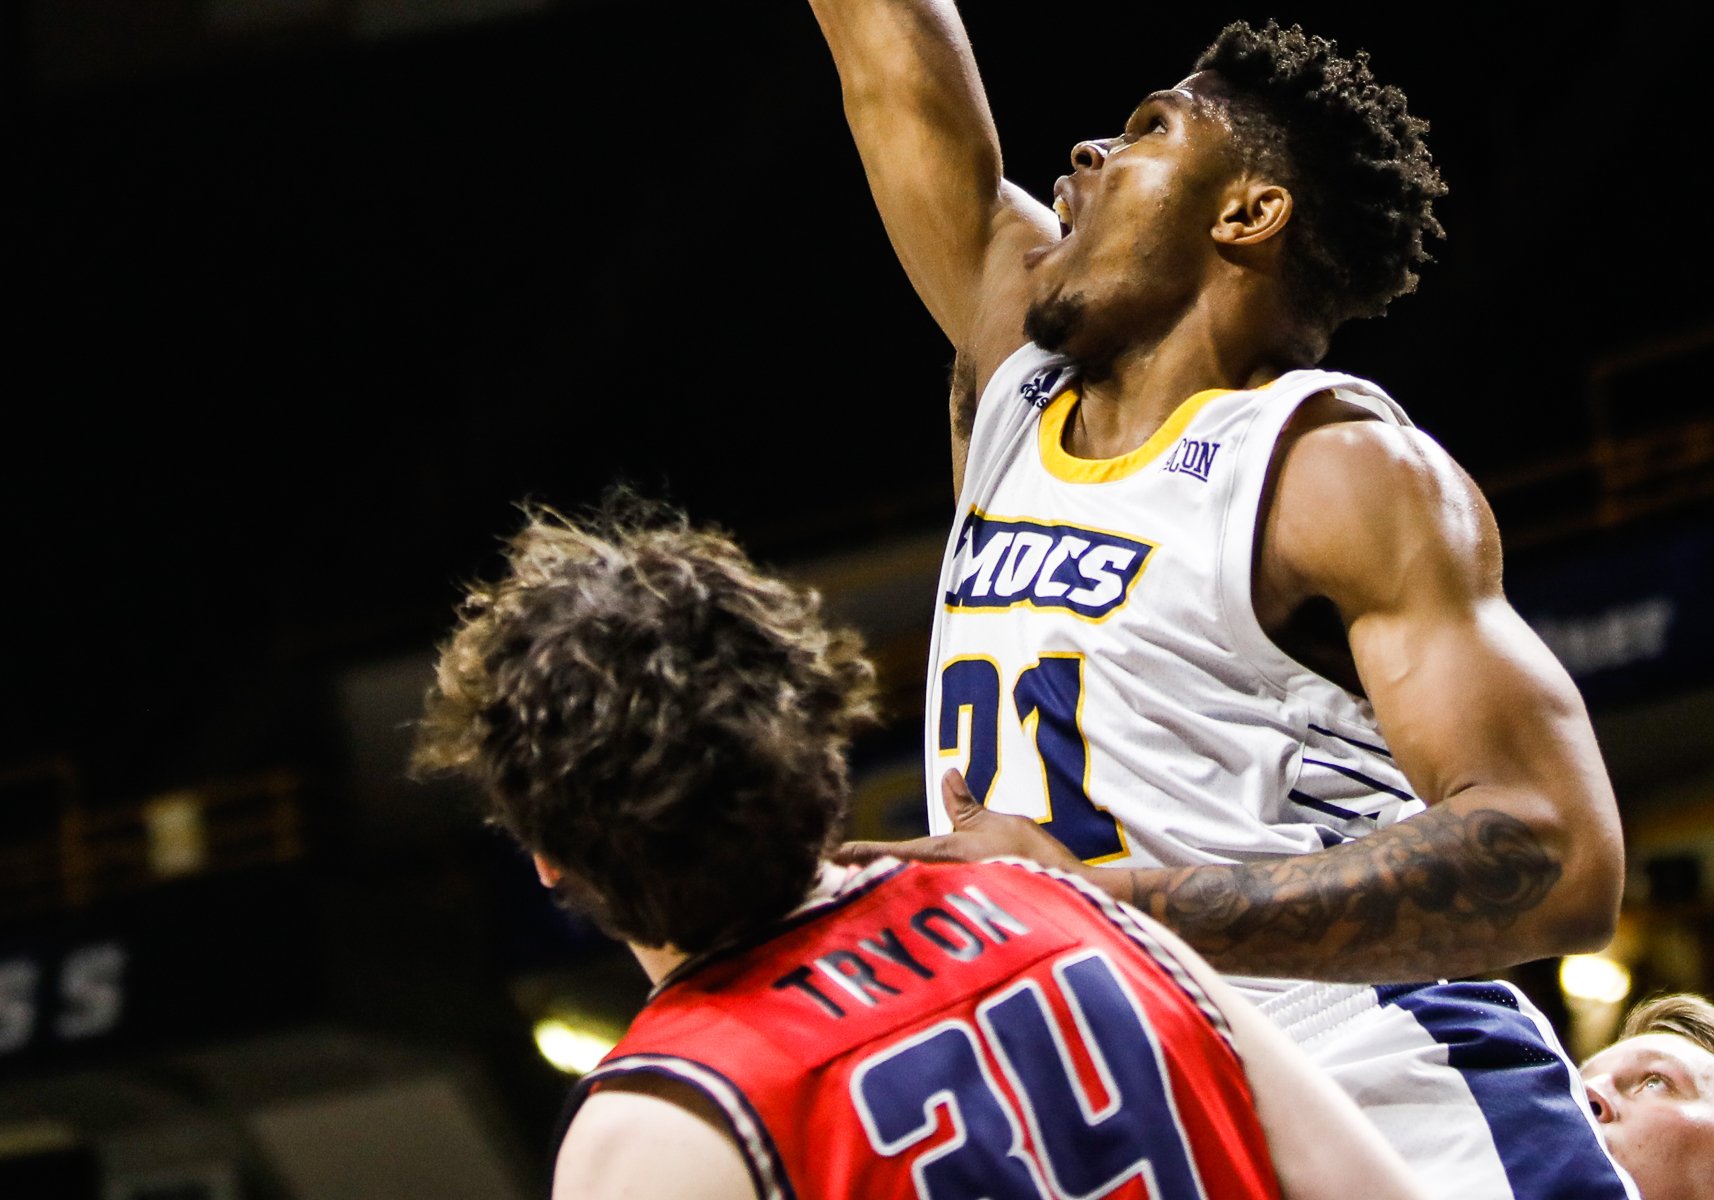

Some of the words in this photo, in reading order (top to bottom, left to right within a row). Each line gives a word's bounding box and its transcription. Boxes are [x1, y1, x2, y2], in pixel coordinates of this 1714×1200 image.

[948, 525, 1137, 607] MOCS
[939, 652, 1131, 866] 21
[772, 886, 1031, 1019] TRYON
[849, 948, 1208, 1200] 34
